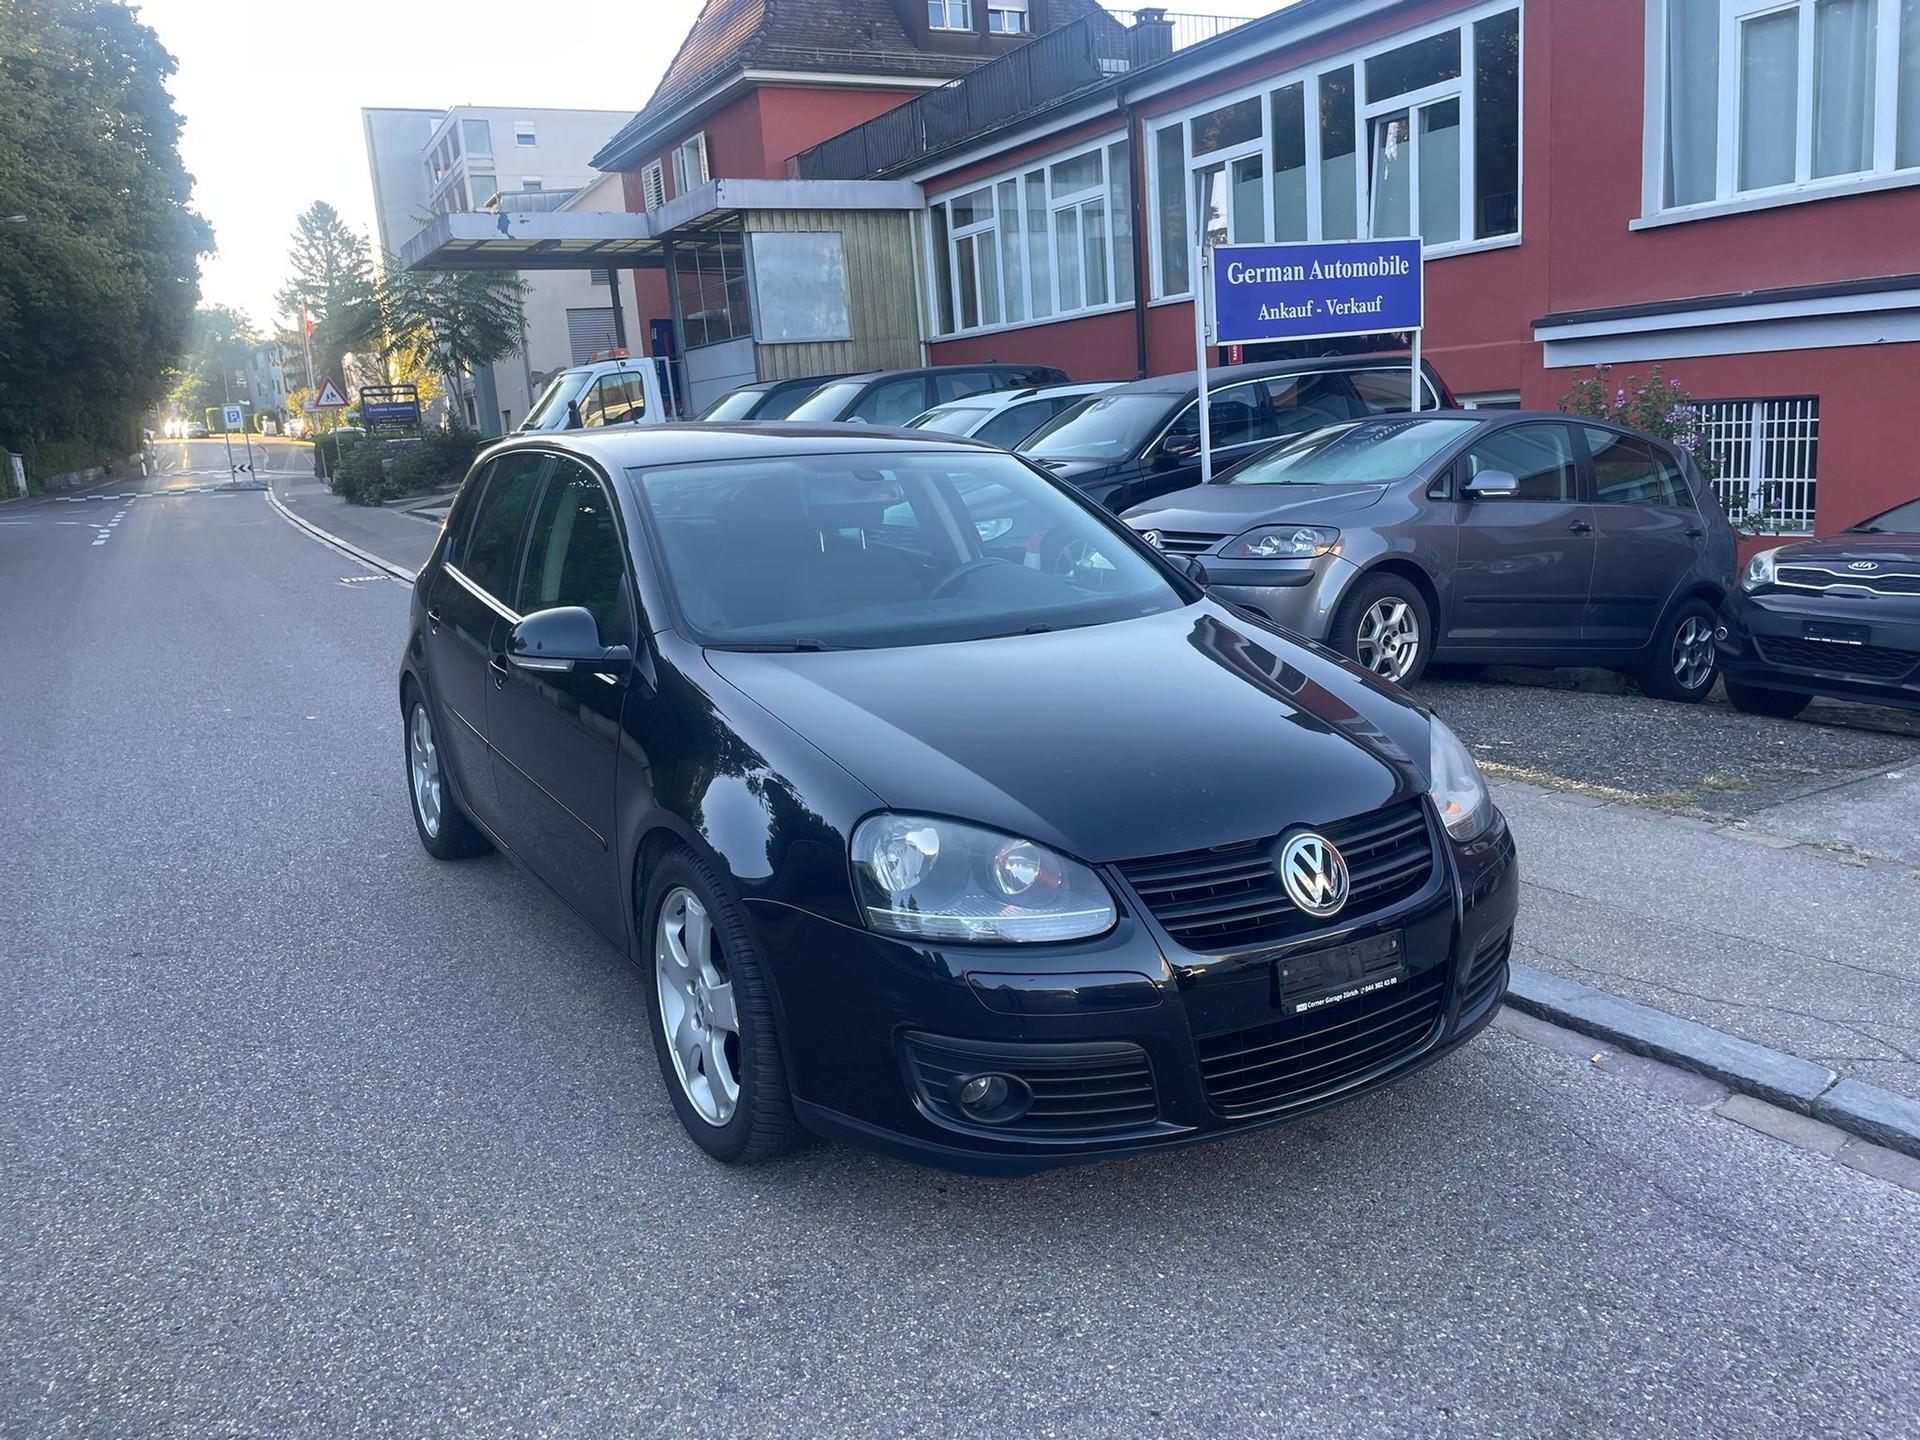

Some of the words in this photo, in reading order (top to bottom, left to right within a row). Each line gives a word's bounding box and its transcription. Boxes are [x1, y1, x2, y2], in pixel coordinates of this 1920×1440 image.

[1227, 261, 1304, 285] German
[1309, 255, 1410, 281] Automobile
[1258, 300, 1314, 321] Ankauf
[1325, 295, 1383, 316] Verkauf
[1283, 835, 1348, 914] VW
[1307, 999, 1325, 1009] Corner
[1325, 994, 1343, 1004] Garage
[1343, 989, 1359, 999] Zürich
